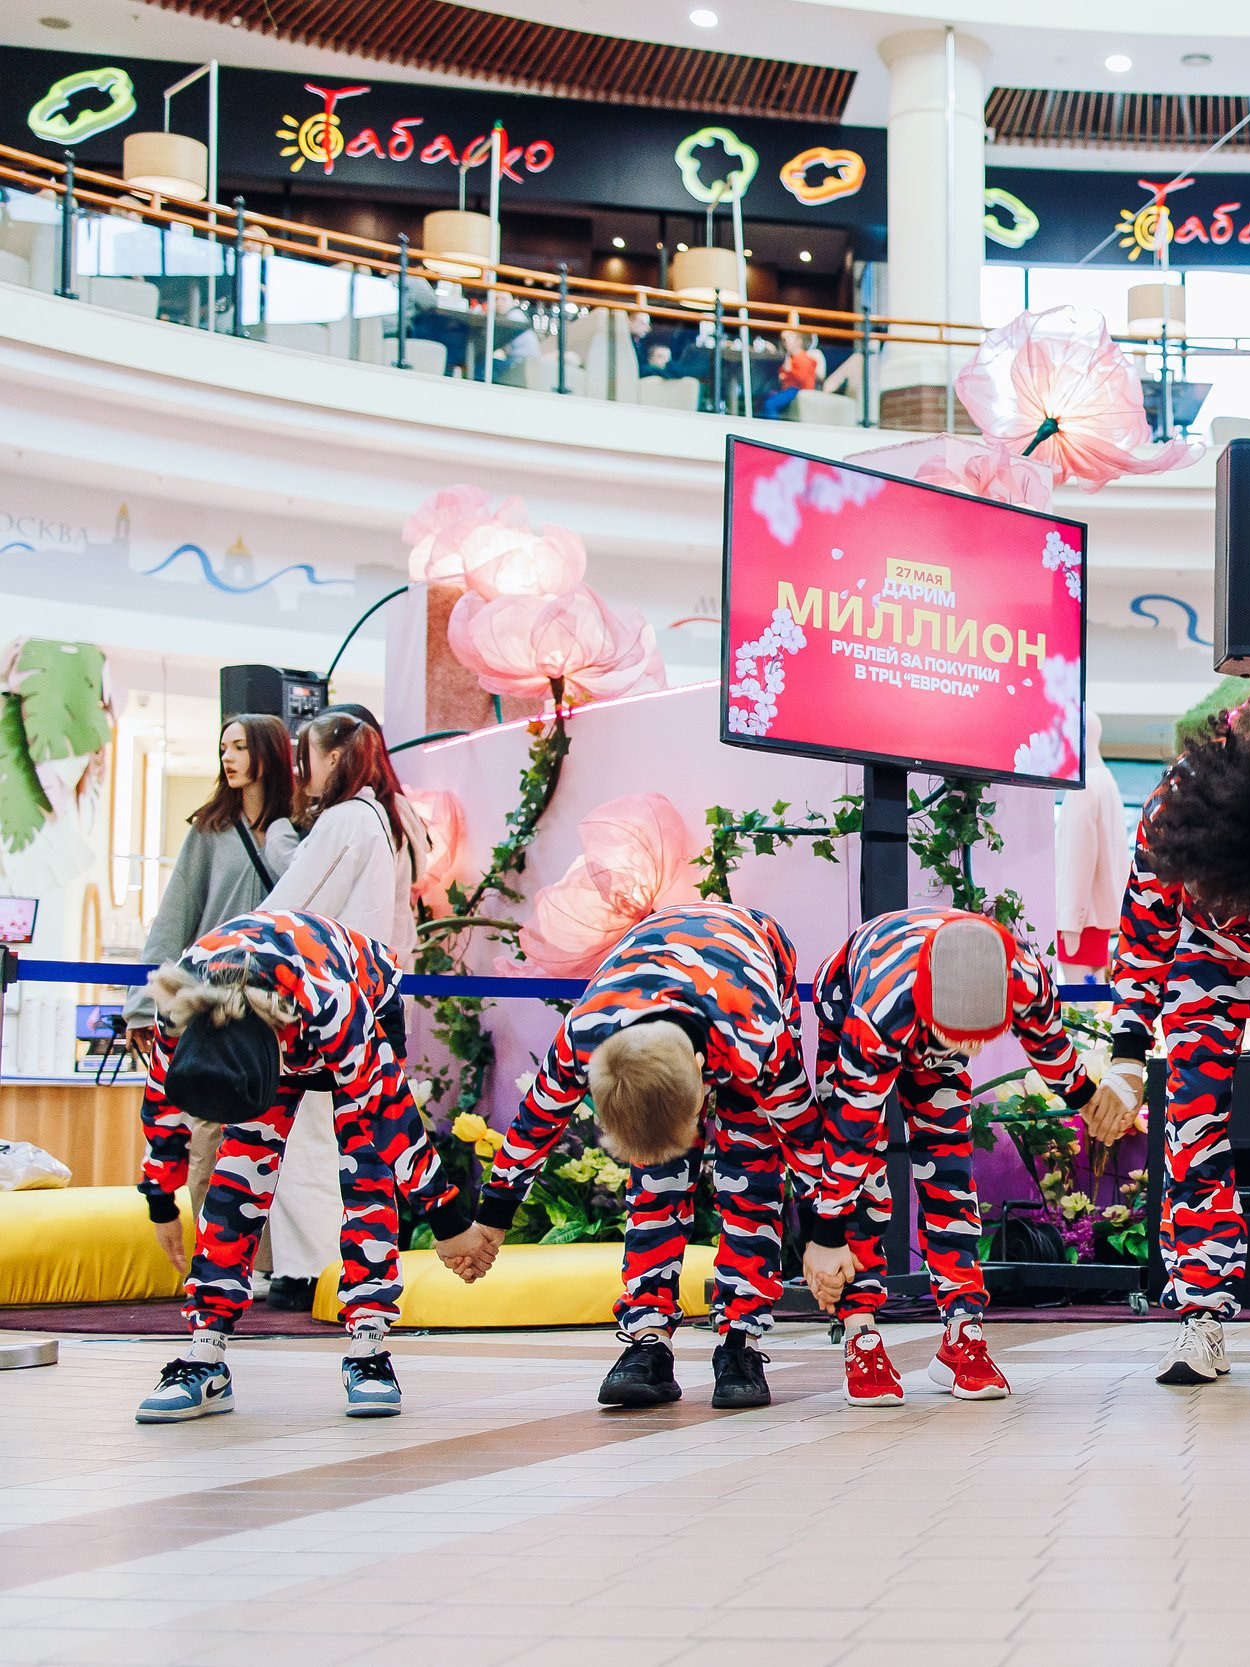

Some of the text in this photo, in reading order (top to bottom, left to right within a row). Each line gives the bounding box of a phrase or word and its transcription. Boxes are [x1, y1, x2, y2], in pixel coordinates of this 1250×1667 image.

[895, 566, 943, 586] 27 МАЯ
[882, 577, 956, 608] ДАРИМ
[777, 580, 1047, 671] МИЛЛИОН
[831, 639, 1000, 684] РУБЛЕЙ ЗА ПОКУПКИ
[854, 663, 867, 680] В
[868, 665, 902, 688] ТРЦ
